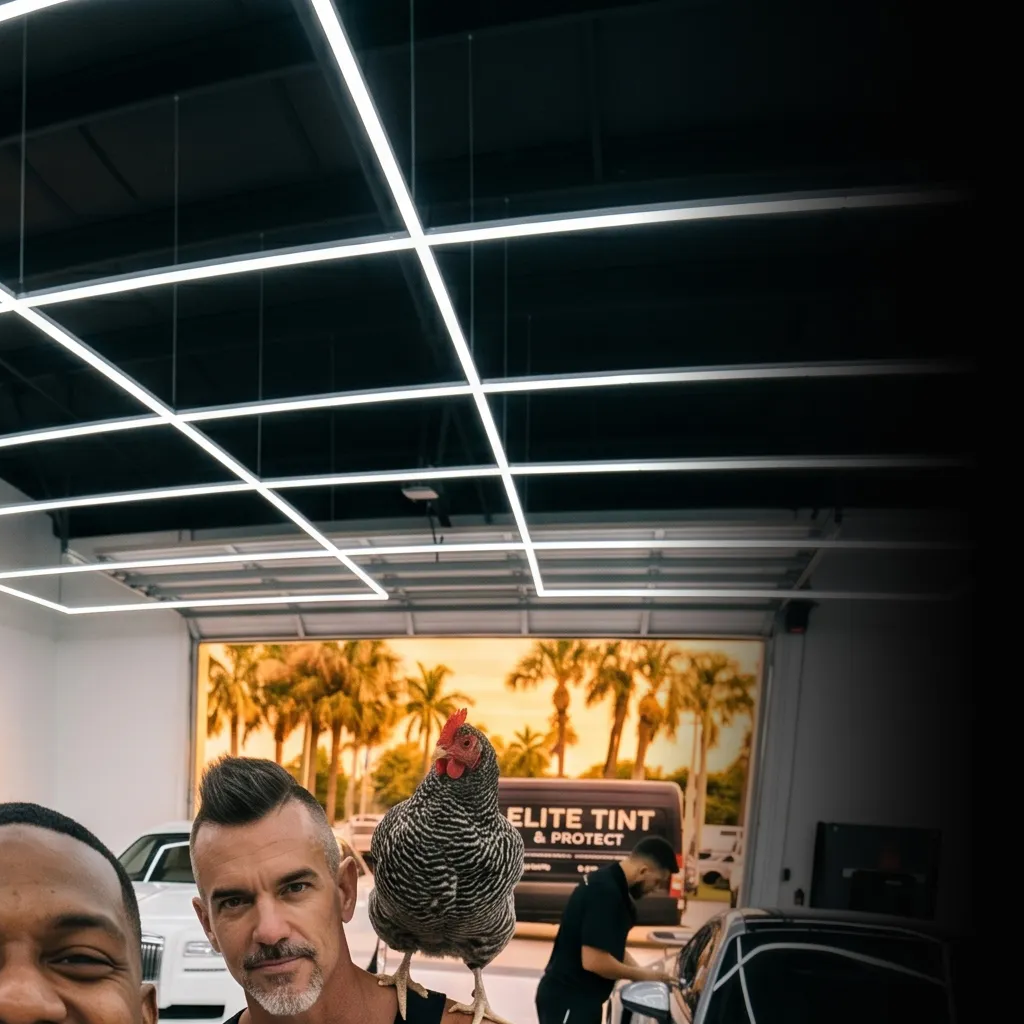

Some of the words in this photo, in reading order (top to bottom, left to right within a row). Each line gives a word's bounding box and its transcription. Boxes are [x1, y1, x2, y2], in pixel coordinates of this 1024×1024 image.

[507, 807, 582, 829] ELITE
[592, 810, 655, 831] TINT
[533, 831, 547, 844] &
[551, 831, 624, 846] PROTECT
